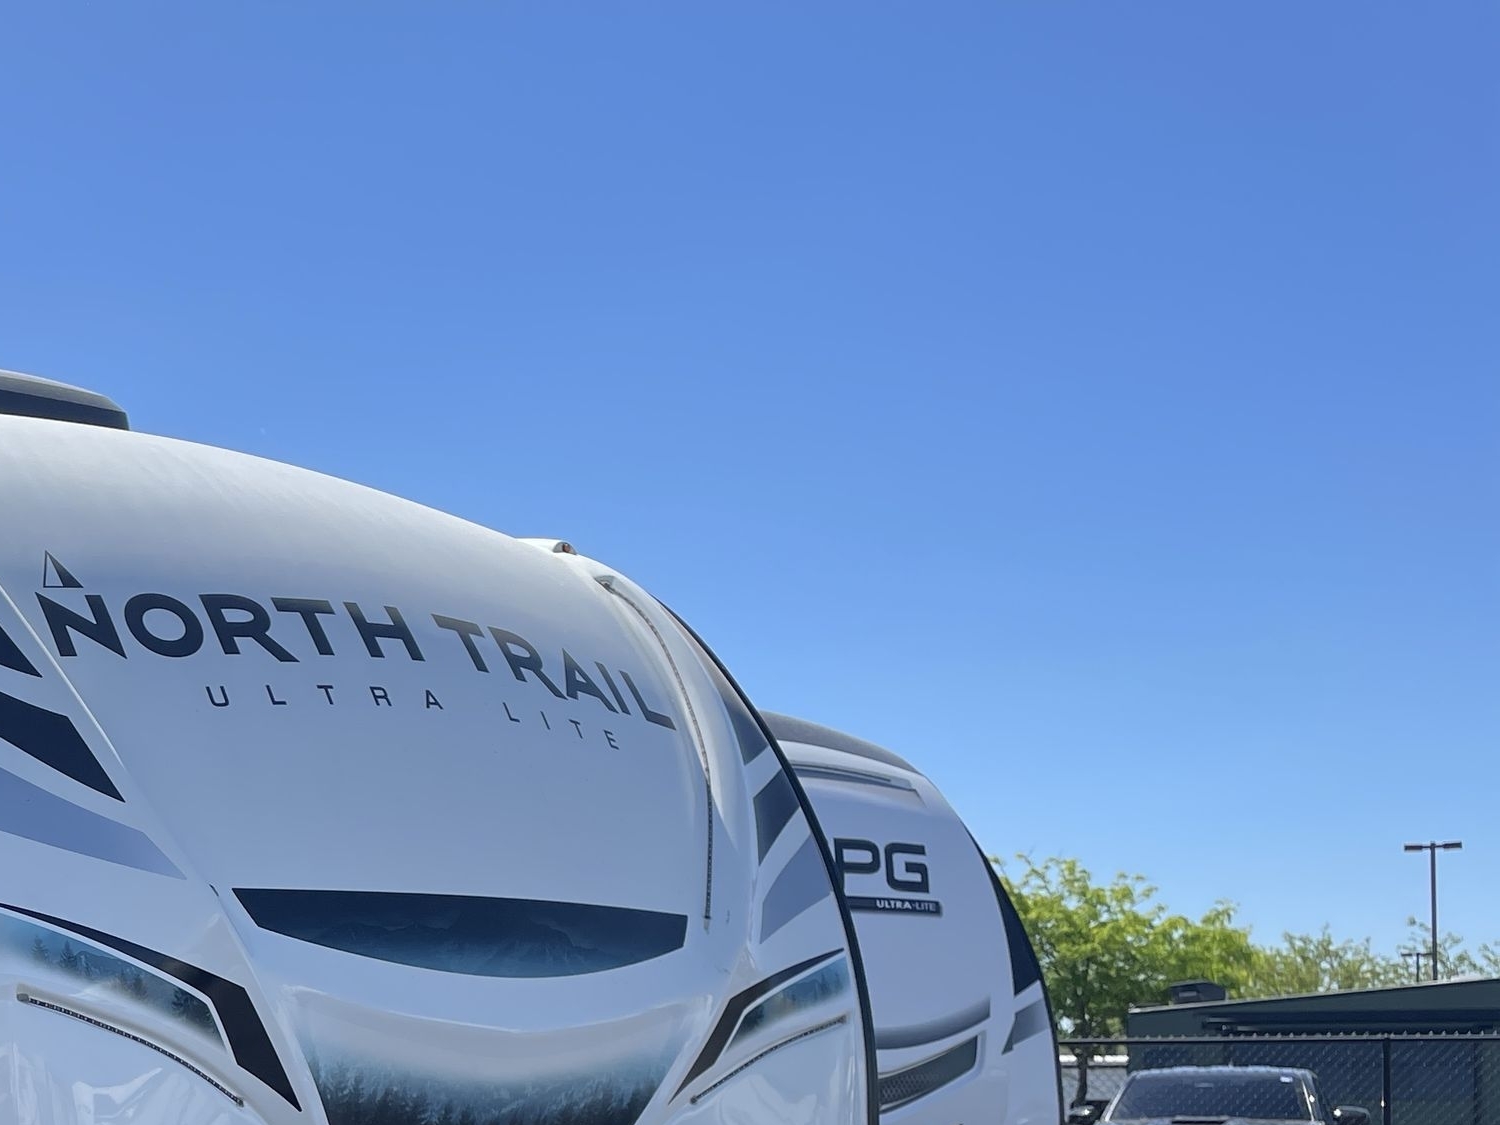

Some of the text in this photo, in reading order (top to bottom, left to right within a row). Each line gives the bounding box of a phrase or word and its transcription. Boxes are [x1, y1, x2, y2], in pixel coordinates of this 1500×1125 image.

[35, 590, 676, 731] NORTH TRAIL
[206, 684, 620, 750] ULTRA LITE
